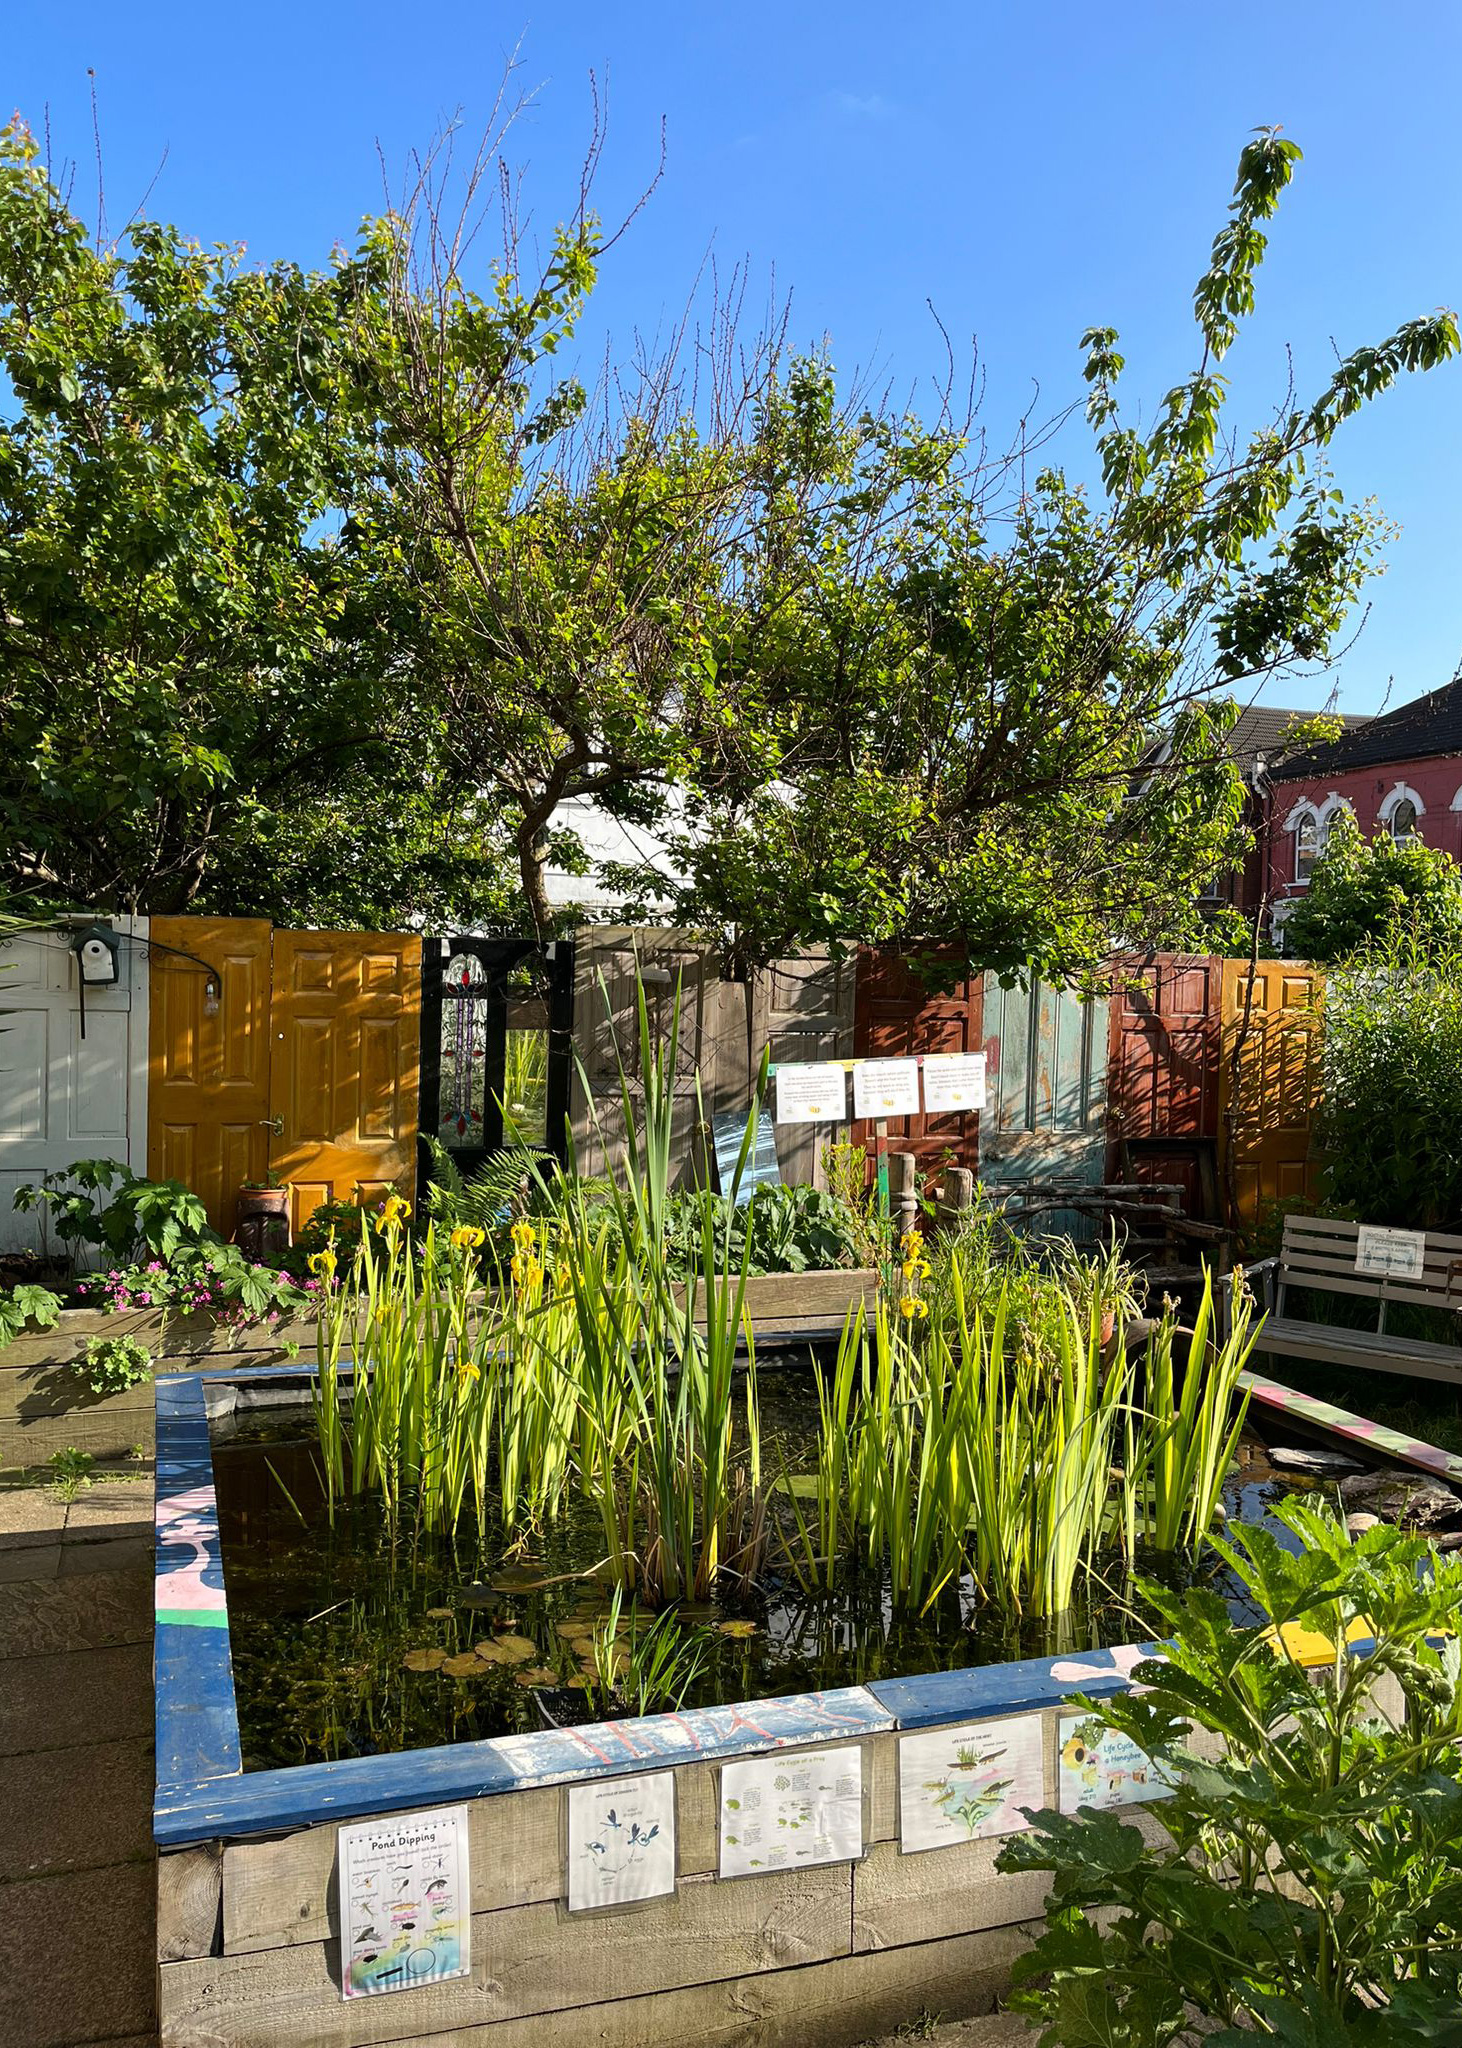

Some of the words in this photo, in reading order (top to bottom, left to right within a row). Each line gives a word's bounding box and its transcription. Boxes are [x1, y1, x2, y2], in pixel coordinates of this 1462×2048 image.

[1103, 1745, 1116, 1755] Life
[1117, 1742, 1134, 1753] Cycle
[1111, 1752, 1142, 1764] Honeybee
[371, 1839, 396, 1852] Pond
[398, 1833, 436, 1847] Dipping
